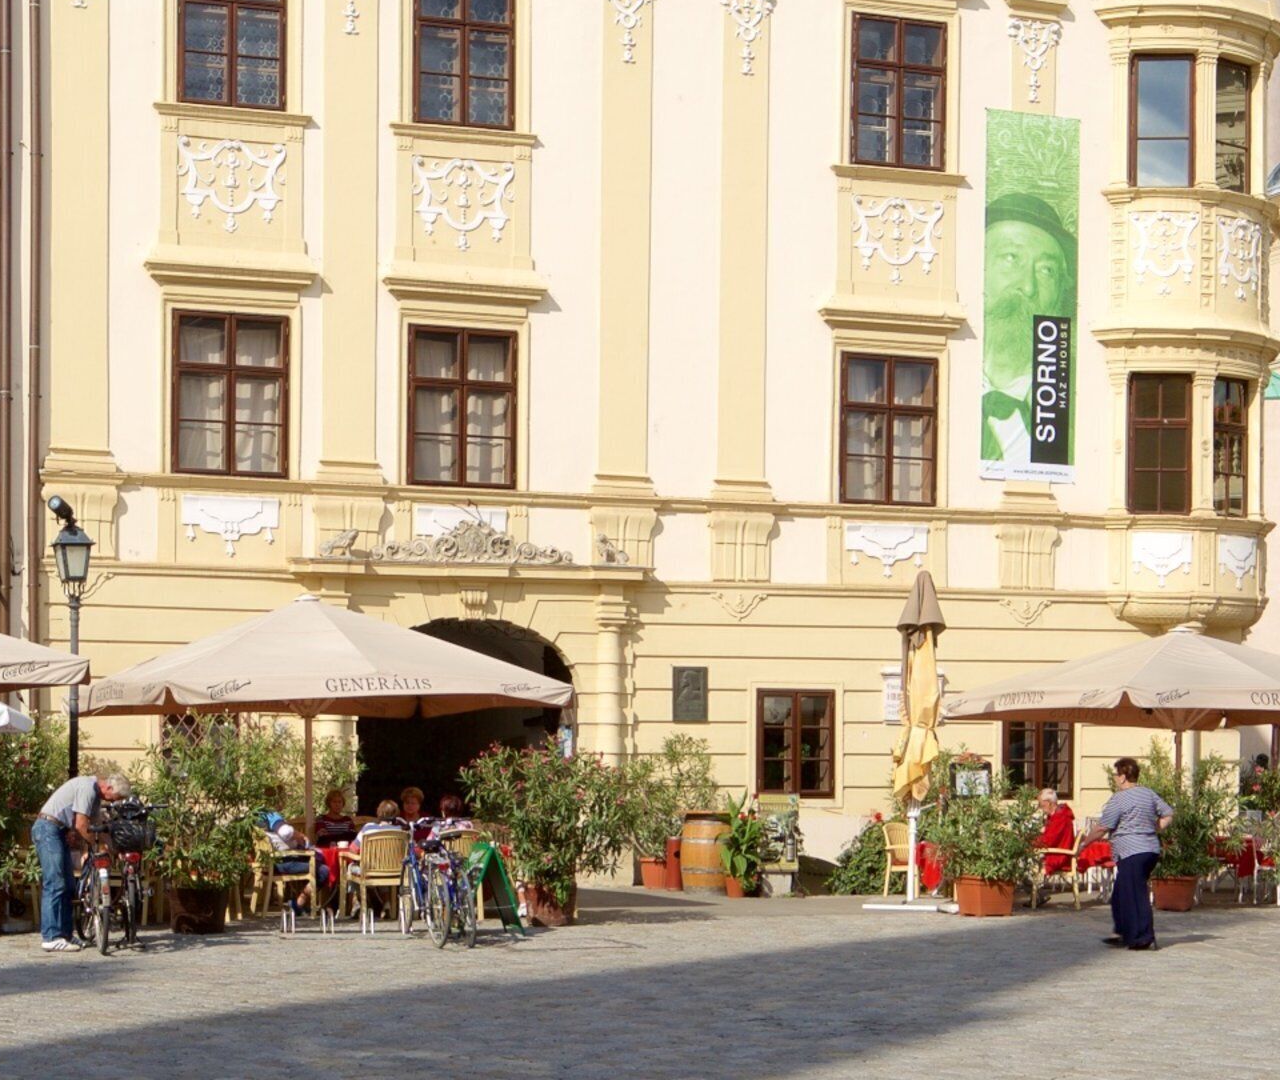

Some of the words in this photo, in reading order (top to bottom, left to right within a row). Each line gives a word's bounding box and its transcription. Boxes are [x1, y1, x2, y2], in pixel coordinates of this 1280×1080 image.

[1059, 322, 1068, 368] HOUSE
[1035, 320, 1058, 443] STORNO
[1058, 382, 1068, 409] HÁZ
[325, 674, 433, 693] GENERÁLIS
